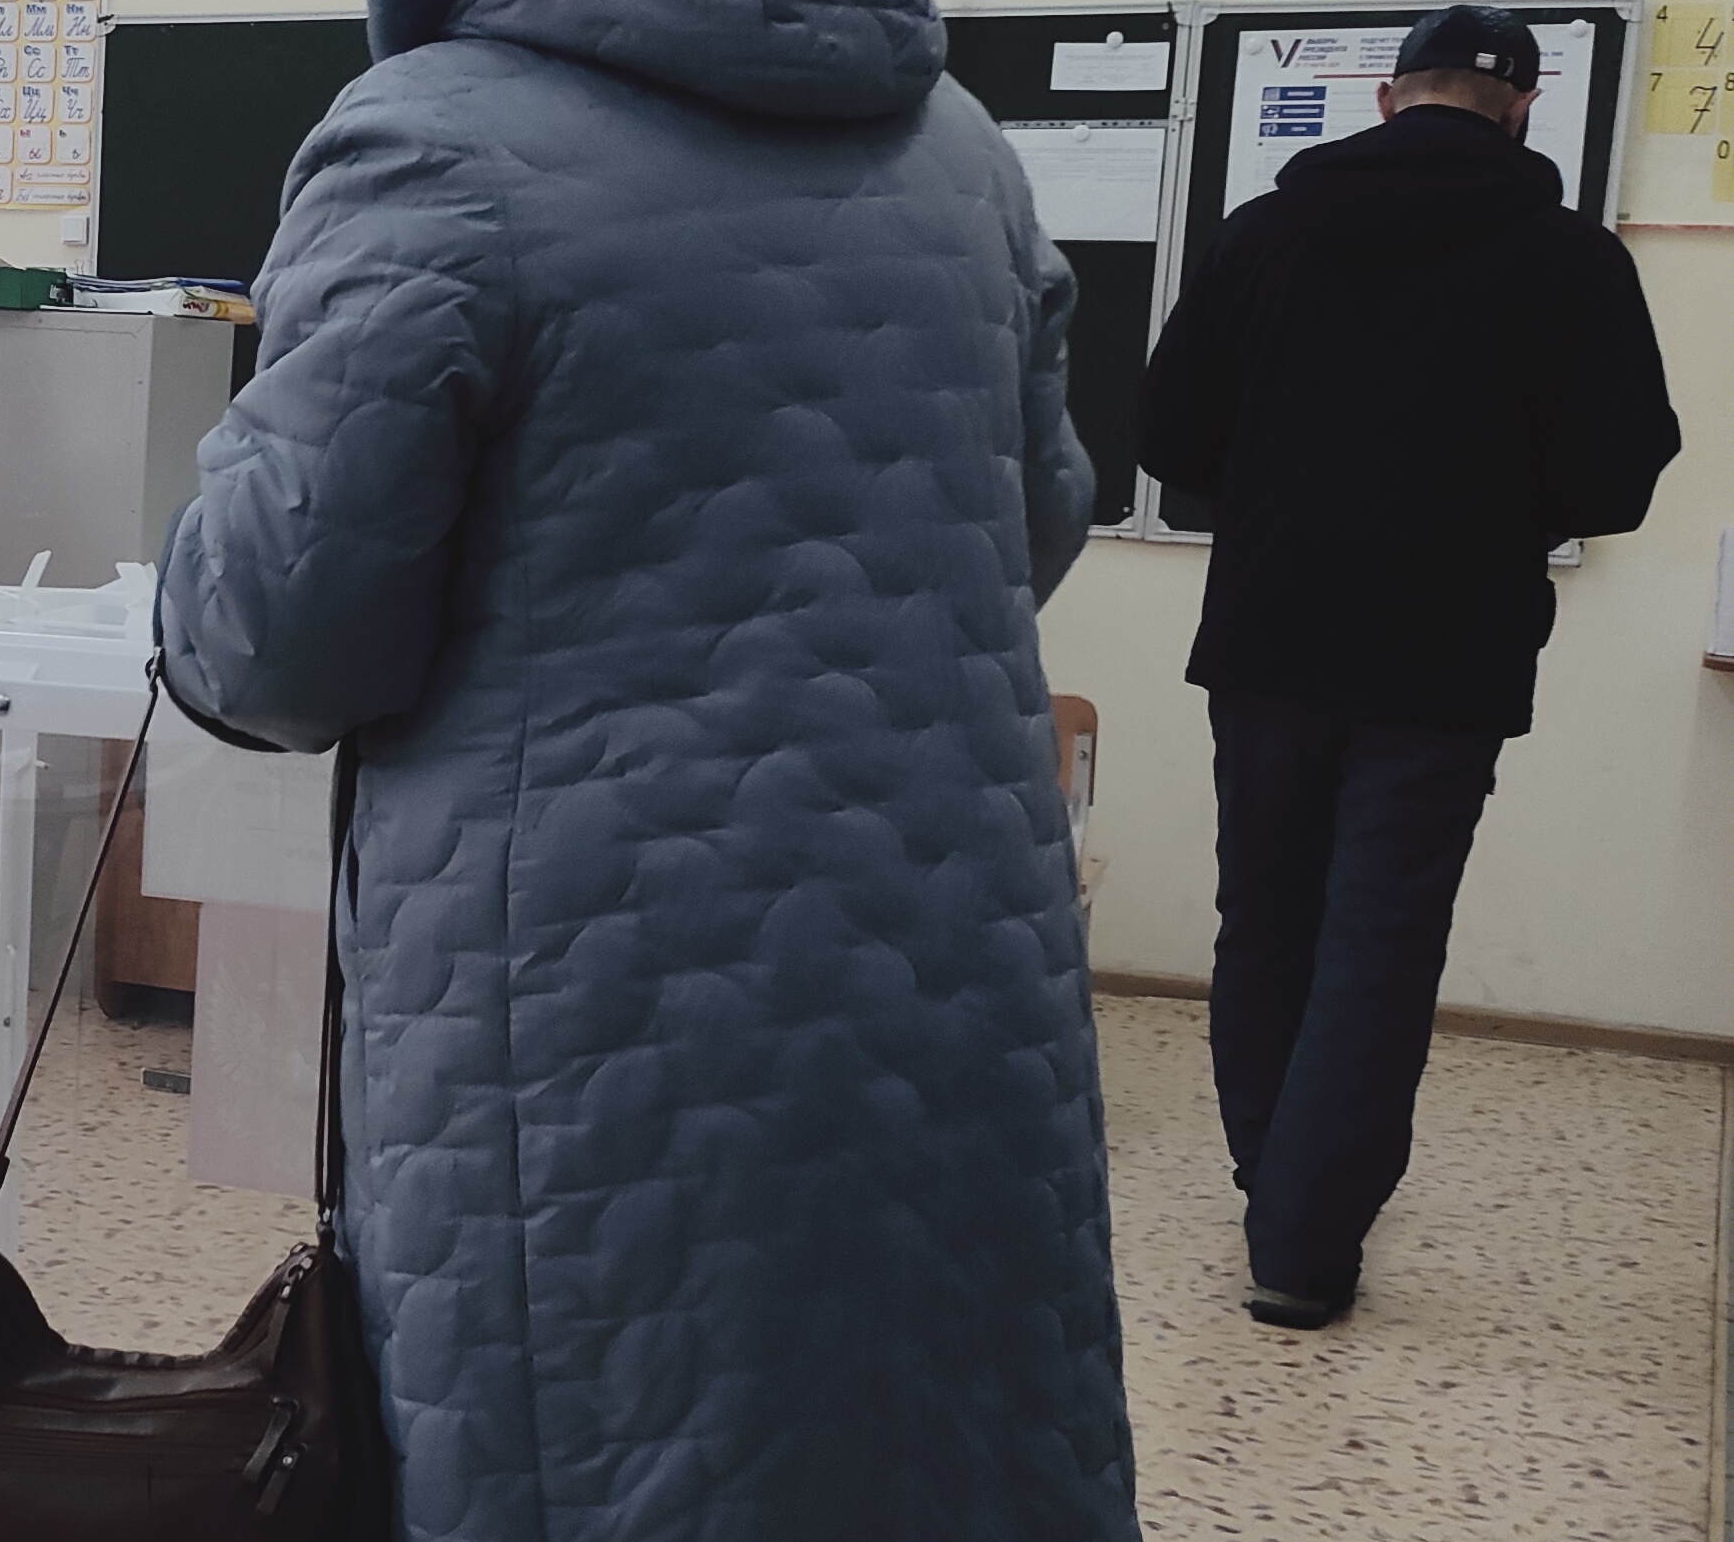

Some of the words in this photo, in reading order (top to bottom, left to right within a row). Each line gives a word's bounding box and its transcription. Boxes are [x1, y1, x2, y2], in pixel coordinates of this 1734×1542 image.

[1656, 5, 1668, 23] 4
[1696, 17, 1724, 66] 4
[1650, 73, 1663, 91] 7
[1690, 86, 1718, 134] 7
[1717, 140, 1730, 159] 0
